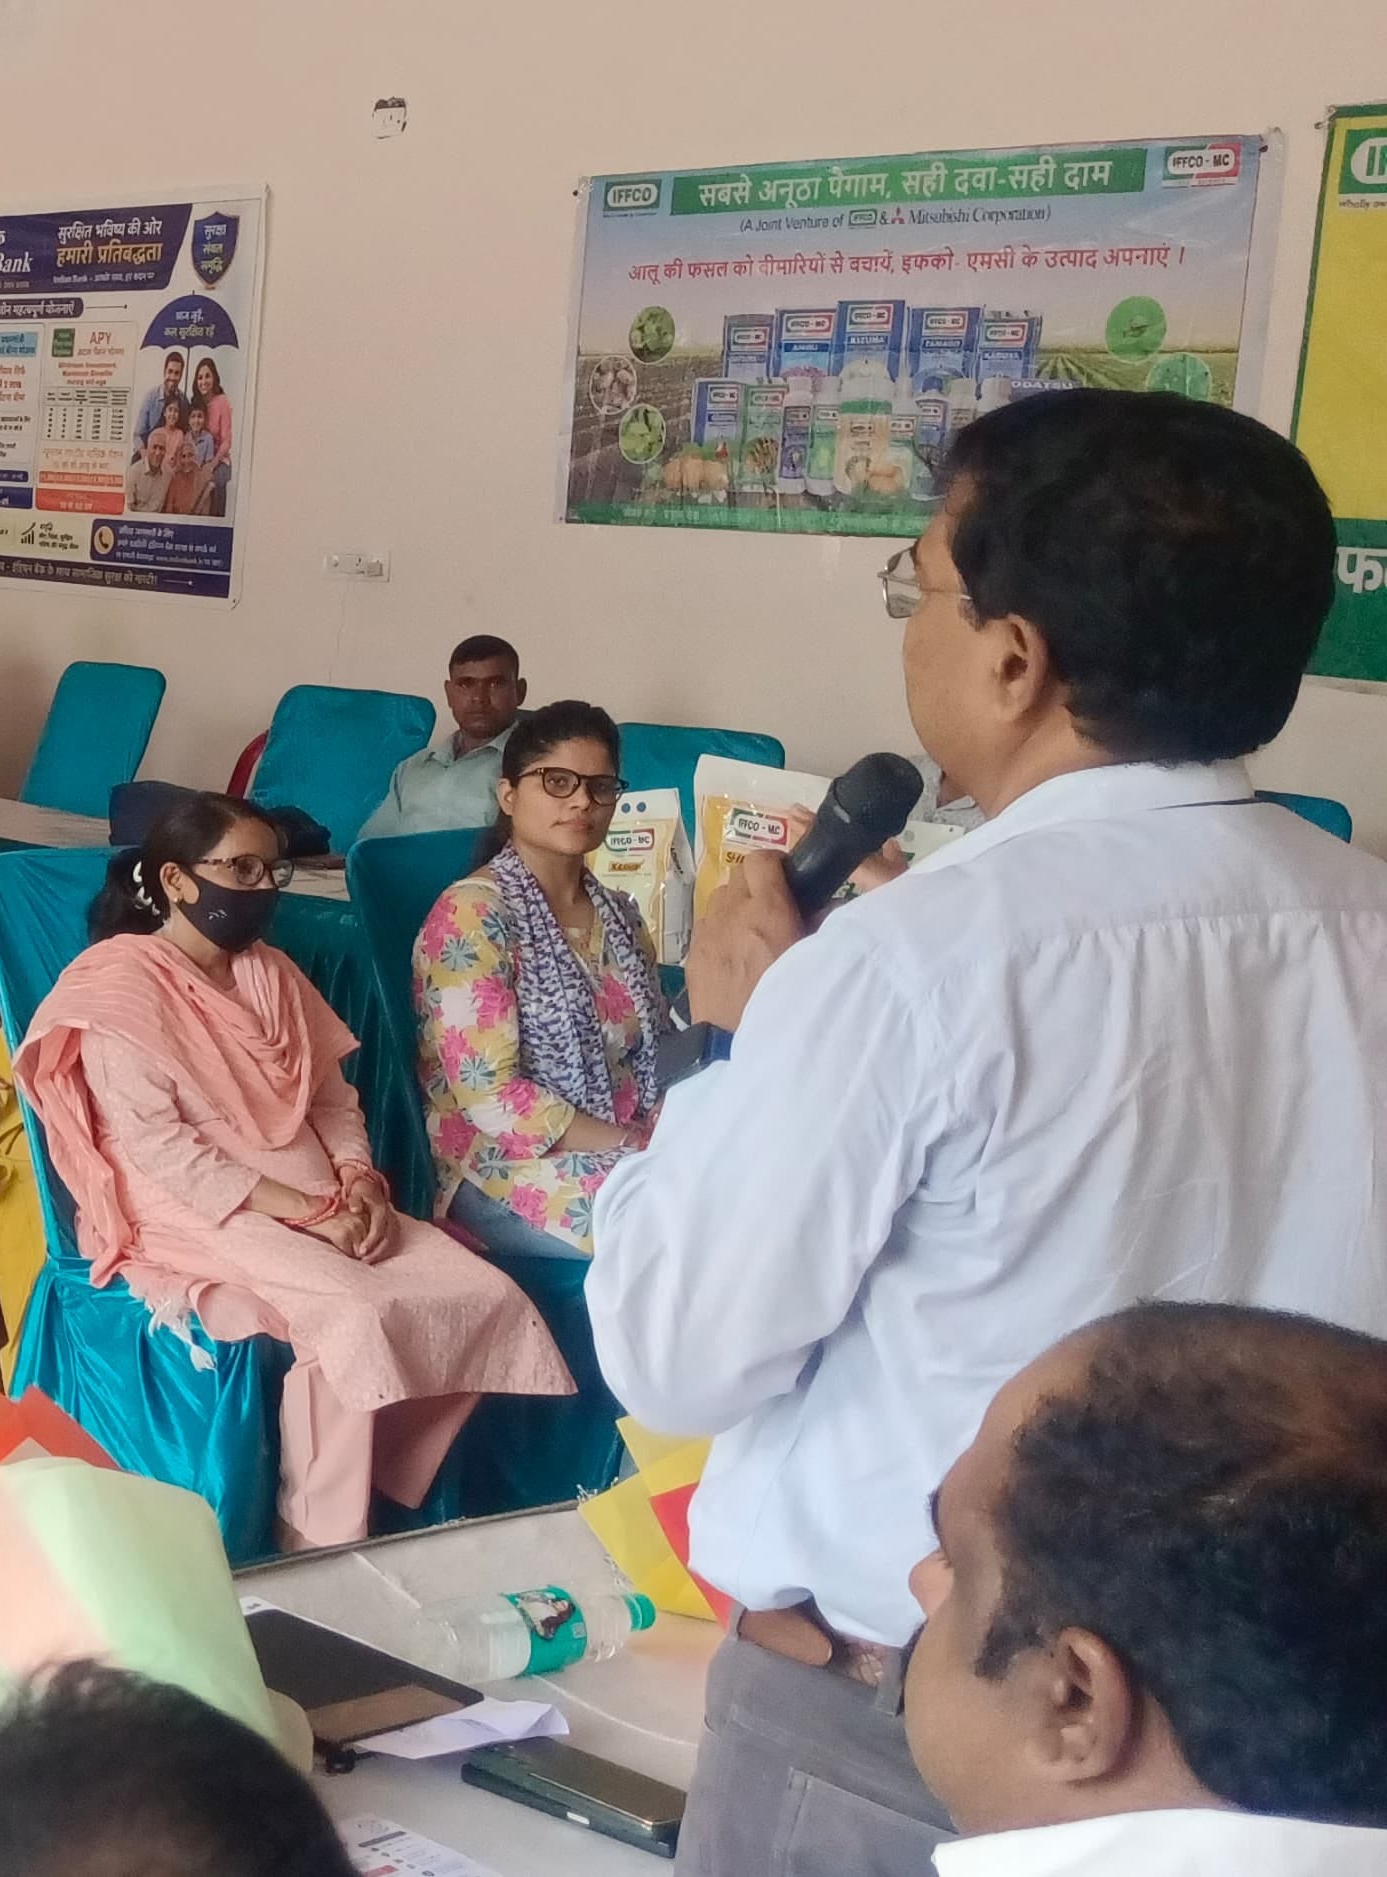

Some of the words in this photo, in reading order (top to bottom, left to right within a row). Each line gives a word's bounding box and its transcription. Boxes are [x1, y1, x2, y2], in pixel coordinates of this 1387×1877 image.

[1172, 156, 1203, 168] IFFCO
[1213, 153, 1230, 167] MC
[612, 187, 652, 203] IFFCO
[699, 174, 752, 207] सबसे
[758, 176, 822, 208] अनूठा
[901, 161, 948, 197] सही
[1063, 160, 1113, 190] दाम
[57, 220, 92, 245] सुरक्षित
[94, 218, 125, 238] भविष्य
[126, 216, 142, 236] की
[142, 216, 163, 235] ओर
[755, 216, 782, 232] Joint
[785, 215, 829, 230] Venture
[832, 214, 843, 228] of
[879, 212, 890, 225] &
[908, 206, 970, 225] Mitsubishi
[972, 203, 1052, 226] Corporation)
[57, 240, 92, 268] हमारी
[96, 238, 163, 265] प्रतिबद्धता
[628, 263, 660, 285] आलू
[663, 257, 684, 279] की
[687, 260, 728, 279] फसल
[732, 254, 753, 277] को
[829, 249, 846, 274] से
[967, 245, 1015, 272] एमसी
[1021, 244, 1038, 266] के
[1044, 248, 1100, 269] उत्पाद
[1102, 242, 1171, 269] अपनाएं
[89, 331, 112, 345] APY
[1336, 546, 1387, 594] फ
[738, 818, 759, 832] IFFCO
[767, 823, 781, 836] MC
